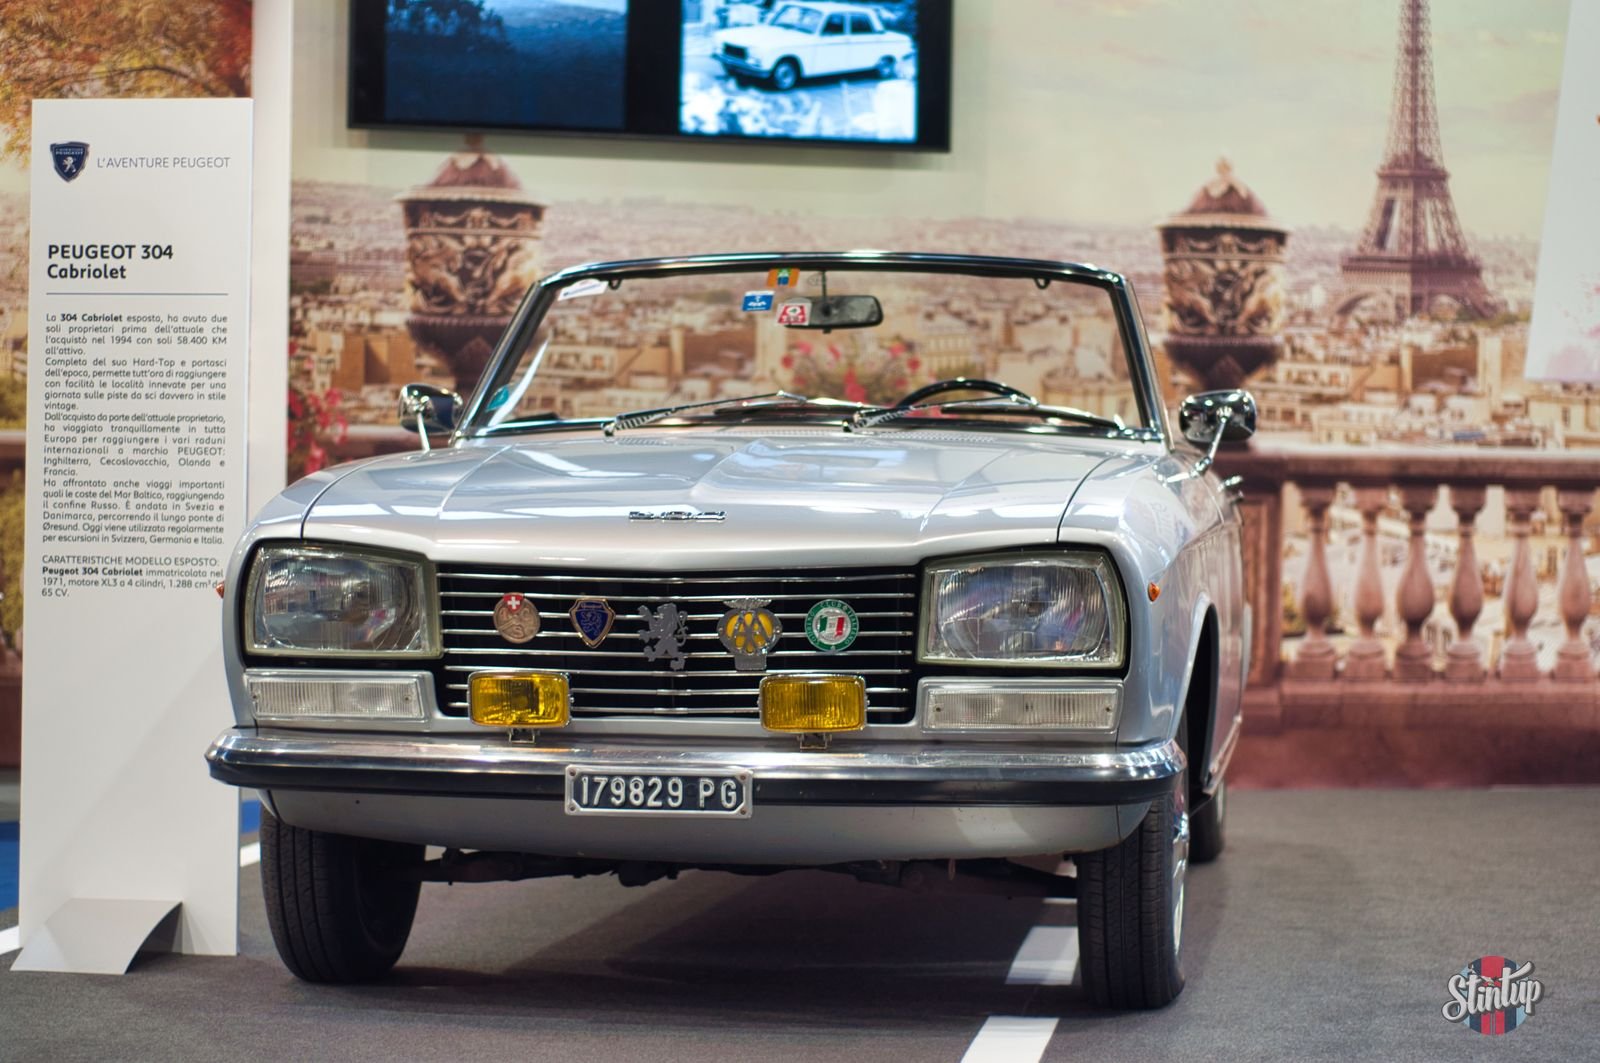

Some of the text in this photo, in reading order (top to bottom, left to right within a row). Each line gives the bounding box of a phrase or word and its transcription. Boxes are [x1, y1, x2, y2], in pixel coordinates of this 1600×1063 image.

[97, 157, 231, 168] L'AVENTURE PEUGEOT
[48, 244, 174, 260] PEUGEOT 304
[47, 264, 126, 279] Cabriolet
[127, 315, 163, 323] esposta,
[68, 326, 114, 334] proprietari
[122, 326, 147, 334] prima
[46, 336, 87, 345] l'acquistò
[45, 358, 87, 367] Completa
[133, 358, 175, 367] Hard-Top
[192, 359, 227, 368] portasci
[45, 369, 91, 378] dell'epoca,
[92, 370, 131, 378] permette
[175, 370, 227, 379] raggiungere
[44, 392, 81, 400] giornata
[107, 392, 128, 400] piste
[44, 402, 79, 411] vintage.
[44, 412, 96, 422] Dall'acquisto
[109, 414, 130, 422] parte
[176, 415, 226, 423] proprietario,
[63, 425, 103, 433] viaggiato
[111, 425, 180, 434] tranquillamente
[44, 434, 77, 444] Europa
[102, 436, 160, 444] raggiungere
[44, 456, 91, 466] Inghilterra,
[100, 457, 170, 467] Cecoslovacchia,
[146, 481, 172, 489] viaggi
[179, 481, 225, 490] importanti
[43, 490, 64, 499] quali
[133, 490, 164, 500] Baltico,
[166, 492, 225, 500] raggiungendo
[125, 499, 131, 509] È
[43, 512, 95, 521] Danimarca,
[98, 513, 151, 522] percorrendo
[161, 514, 186, 522] lungo
[188, 514, 214, 523] ponte
[82, 523, 103, 532] Oggi
[167, 525, 224, 534] regolarmente
[111, 534, 147, 544] Svizzera,
[42, 556, 123, 564] CARATTERISTICHE
[42, 566, 79, 576] Peugeot
[43, 578, 66, 587] 1971,
[135, 579, 166, 588] cilindri,
[581, 776, 737, 808] 179829 PG
